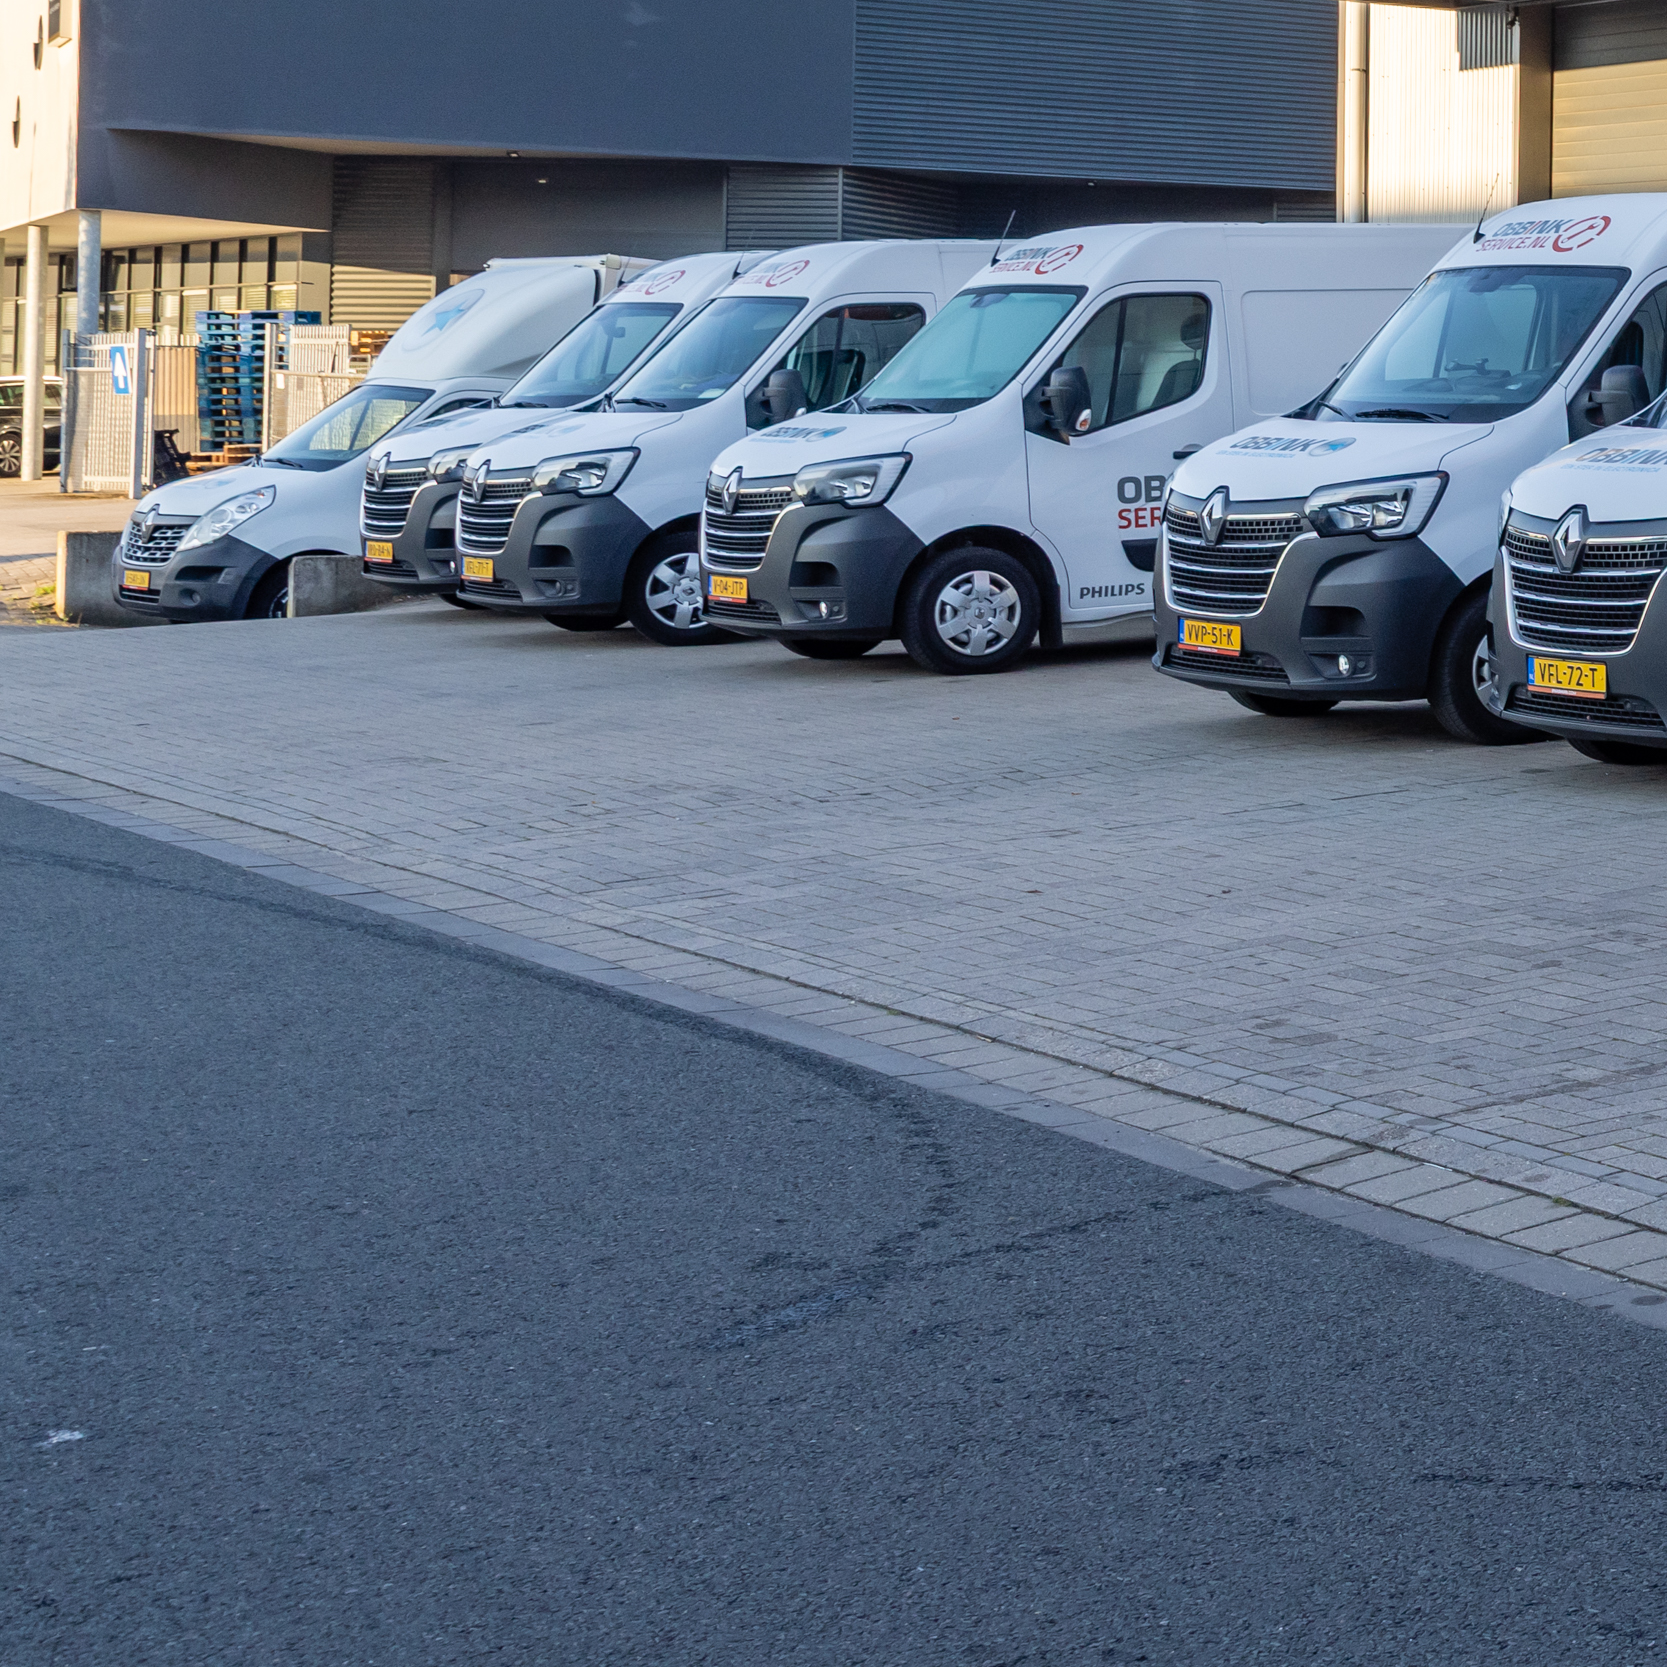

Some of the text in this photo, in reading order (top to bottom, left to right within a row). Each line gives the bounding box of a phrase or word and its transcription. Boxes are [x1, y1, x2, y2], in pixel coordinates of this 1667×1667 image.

[1491, 218, 1576, 238] OBBINK
[1475, 235, 1552, 252] SERVICE.NL
[1230, 436, 1331, 452] OBBINK
[1080, 582, 1145, 599] PHILIPS
[1187, 623, 1234, 647] VVP-51-K
[1538, 662, 1598, 688] VFL-72-T
